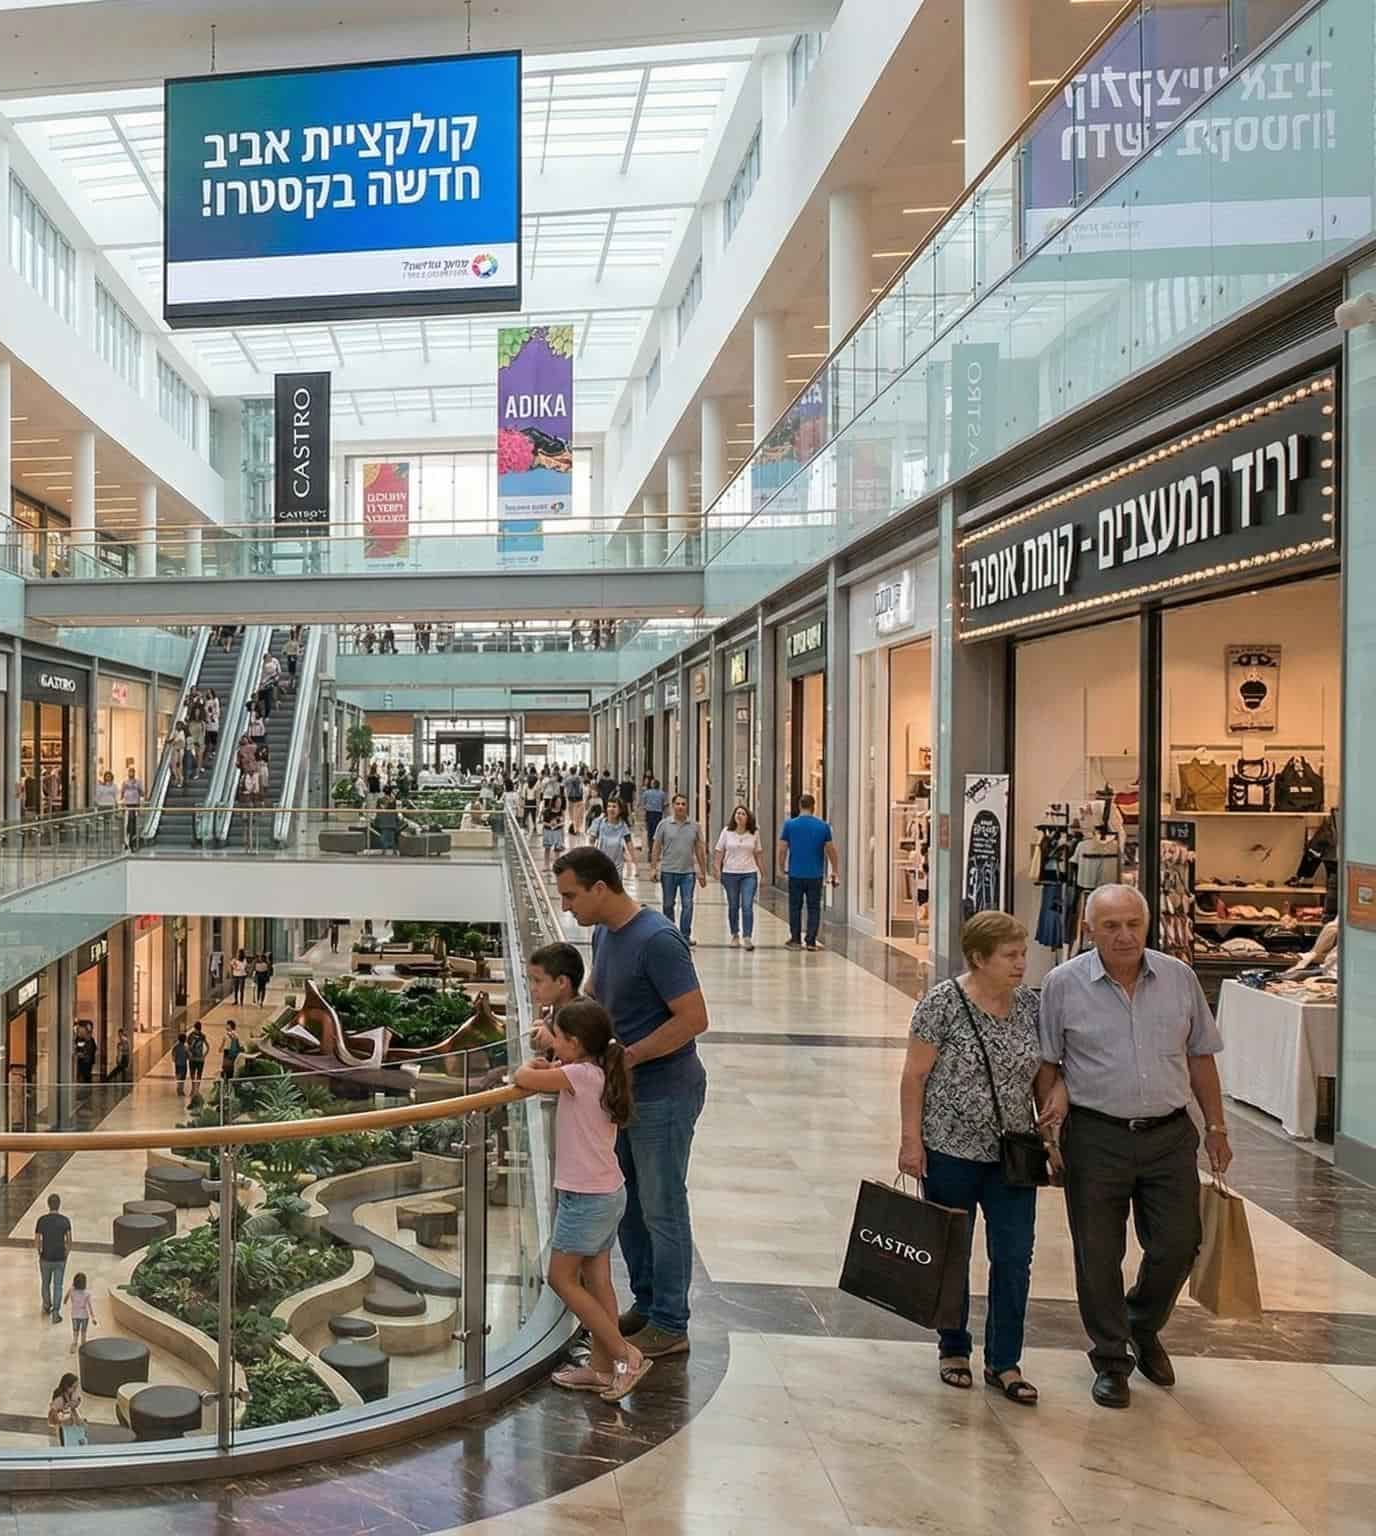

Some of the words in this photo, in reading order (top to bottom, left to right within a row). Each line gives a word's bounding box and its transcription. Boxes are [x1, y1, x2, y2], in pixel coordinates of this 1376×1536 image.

[203, 128, 291, 169] אביב
[301, 112, 478, 165] קולקציית
[201, 173, 356, 219] בקסטרו!
[368, 165, 480, 207] חדשה
[505, 393, 568, 419] ADIKA
[293, 387, 311, 499] CASTRO
[1232, 433, 1301, 529] יריד
[1098, 465, 1222, 571] המעצבים
[1022, 522, 1075, 597] קומת
[1080, 536, 1095, 553] -
[969, 544, 1017, 610] אופנה
[859, 1228, 932, 1265] CASTRO
